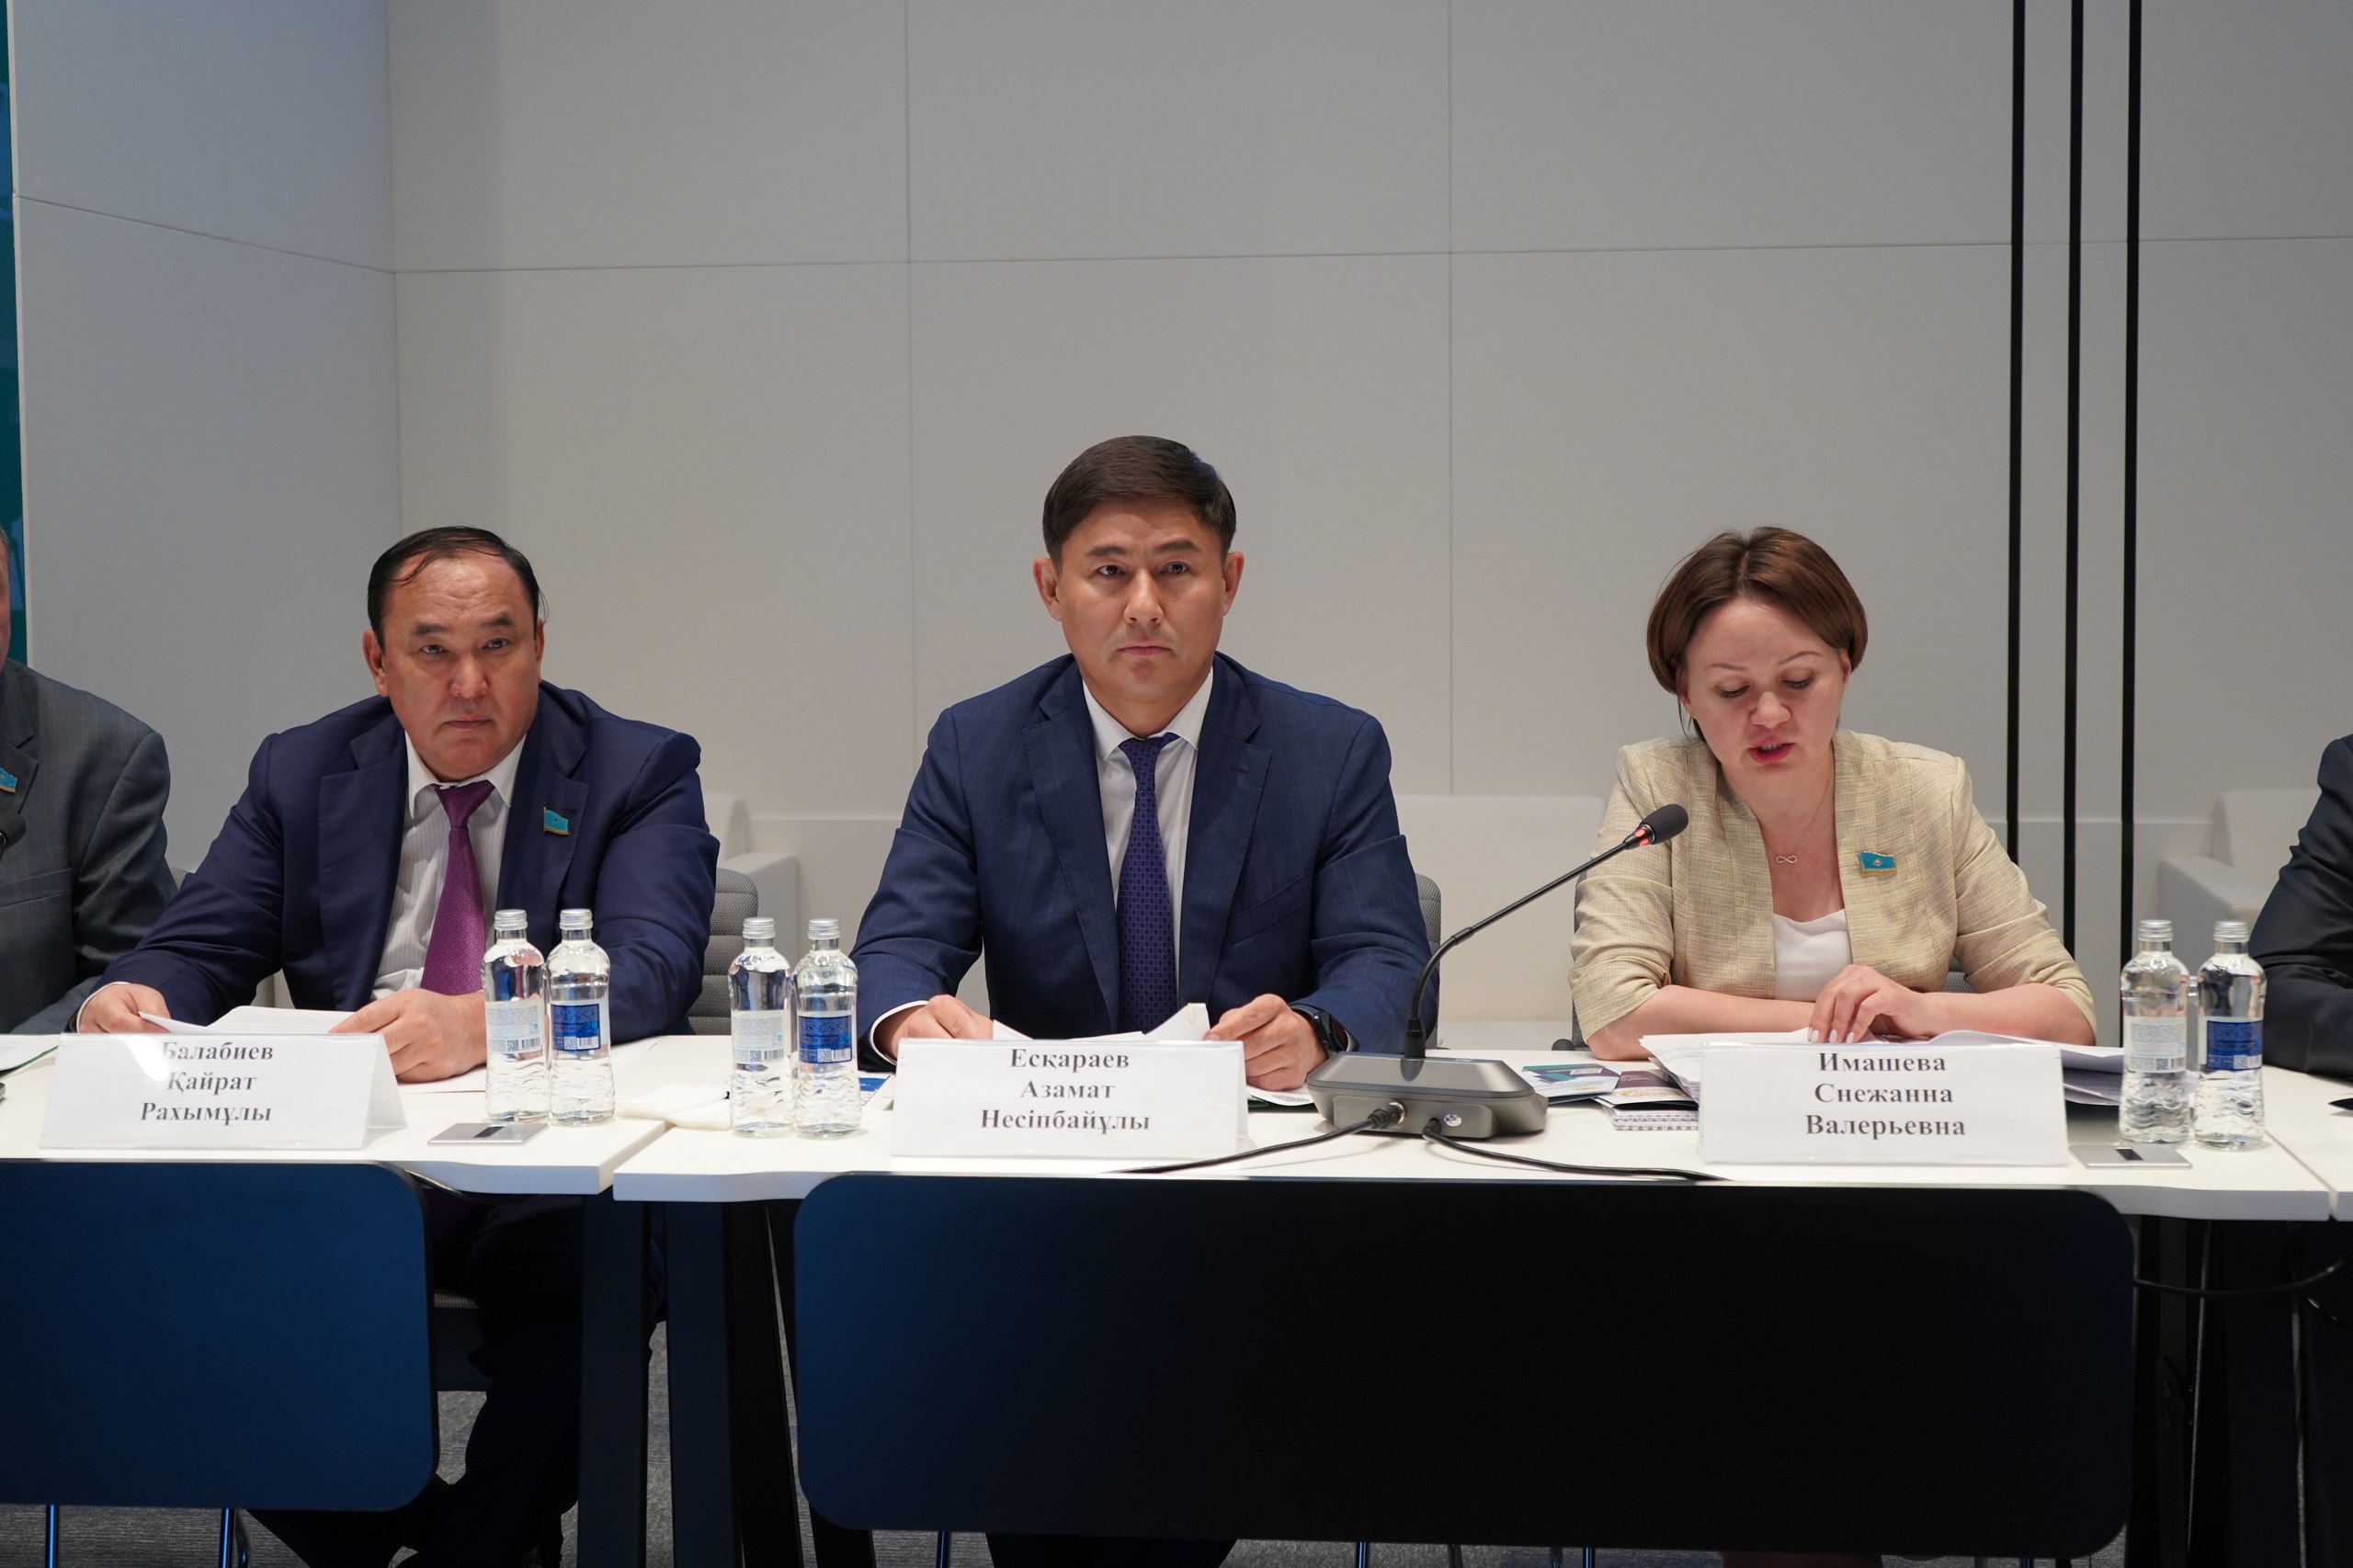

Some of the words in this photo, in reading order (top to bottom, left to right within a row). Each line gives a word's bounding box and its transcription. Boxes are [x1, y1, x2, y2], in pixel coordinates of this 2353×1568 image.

[162, 1040, 274, 1061] Балабиев
[1818, 1052, 1947, 1073] Имашева
[166, 1071, 257, 1096] Қайрат
[1019, 1080, 1116, 1099] Азамат
[1814, 1083, 1954, 1103] Снежанна
[140, 1102, 272, 1127] Рахымұлы
[981, 1109, 1151, 1135] Несіпбайұлы
[1805, 1114, 1966, 1141] Валерьевна
